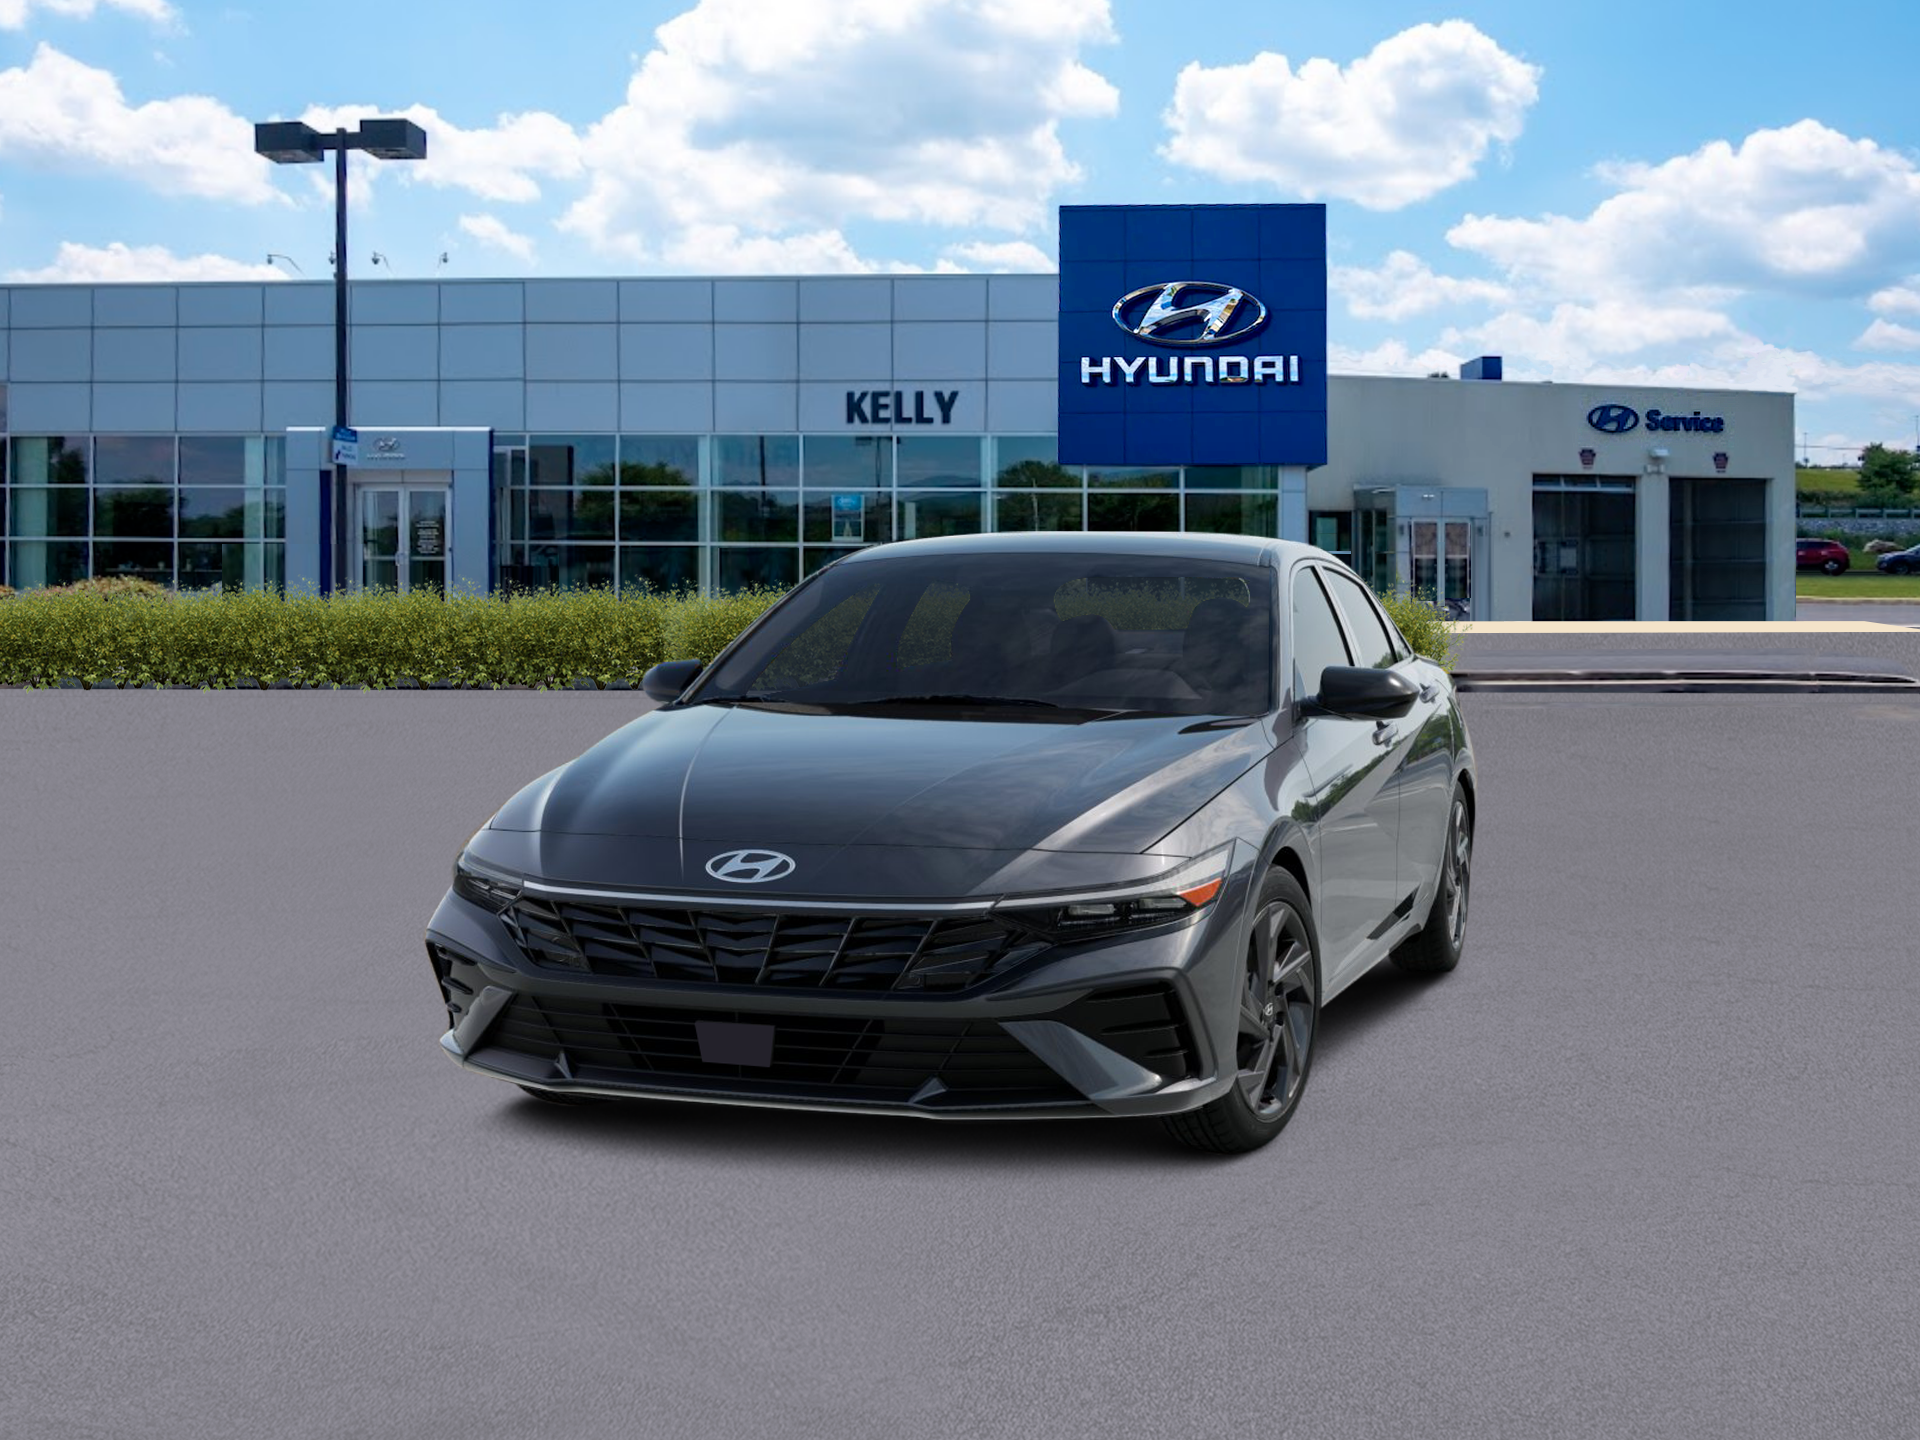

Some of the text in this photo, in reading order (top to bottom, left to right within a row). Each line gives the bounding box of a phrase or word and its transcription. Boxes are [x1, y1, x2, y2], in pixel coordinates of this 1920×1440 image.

[1080, 355, 1300, 384] HYUNDAI
[846, 390, 959, 425] KELLY
[1645, 409, 1724, 433] Service
